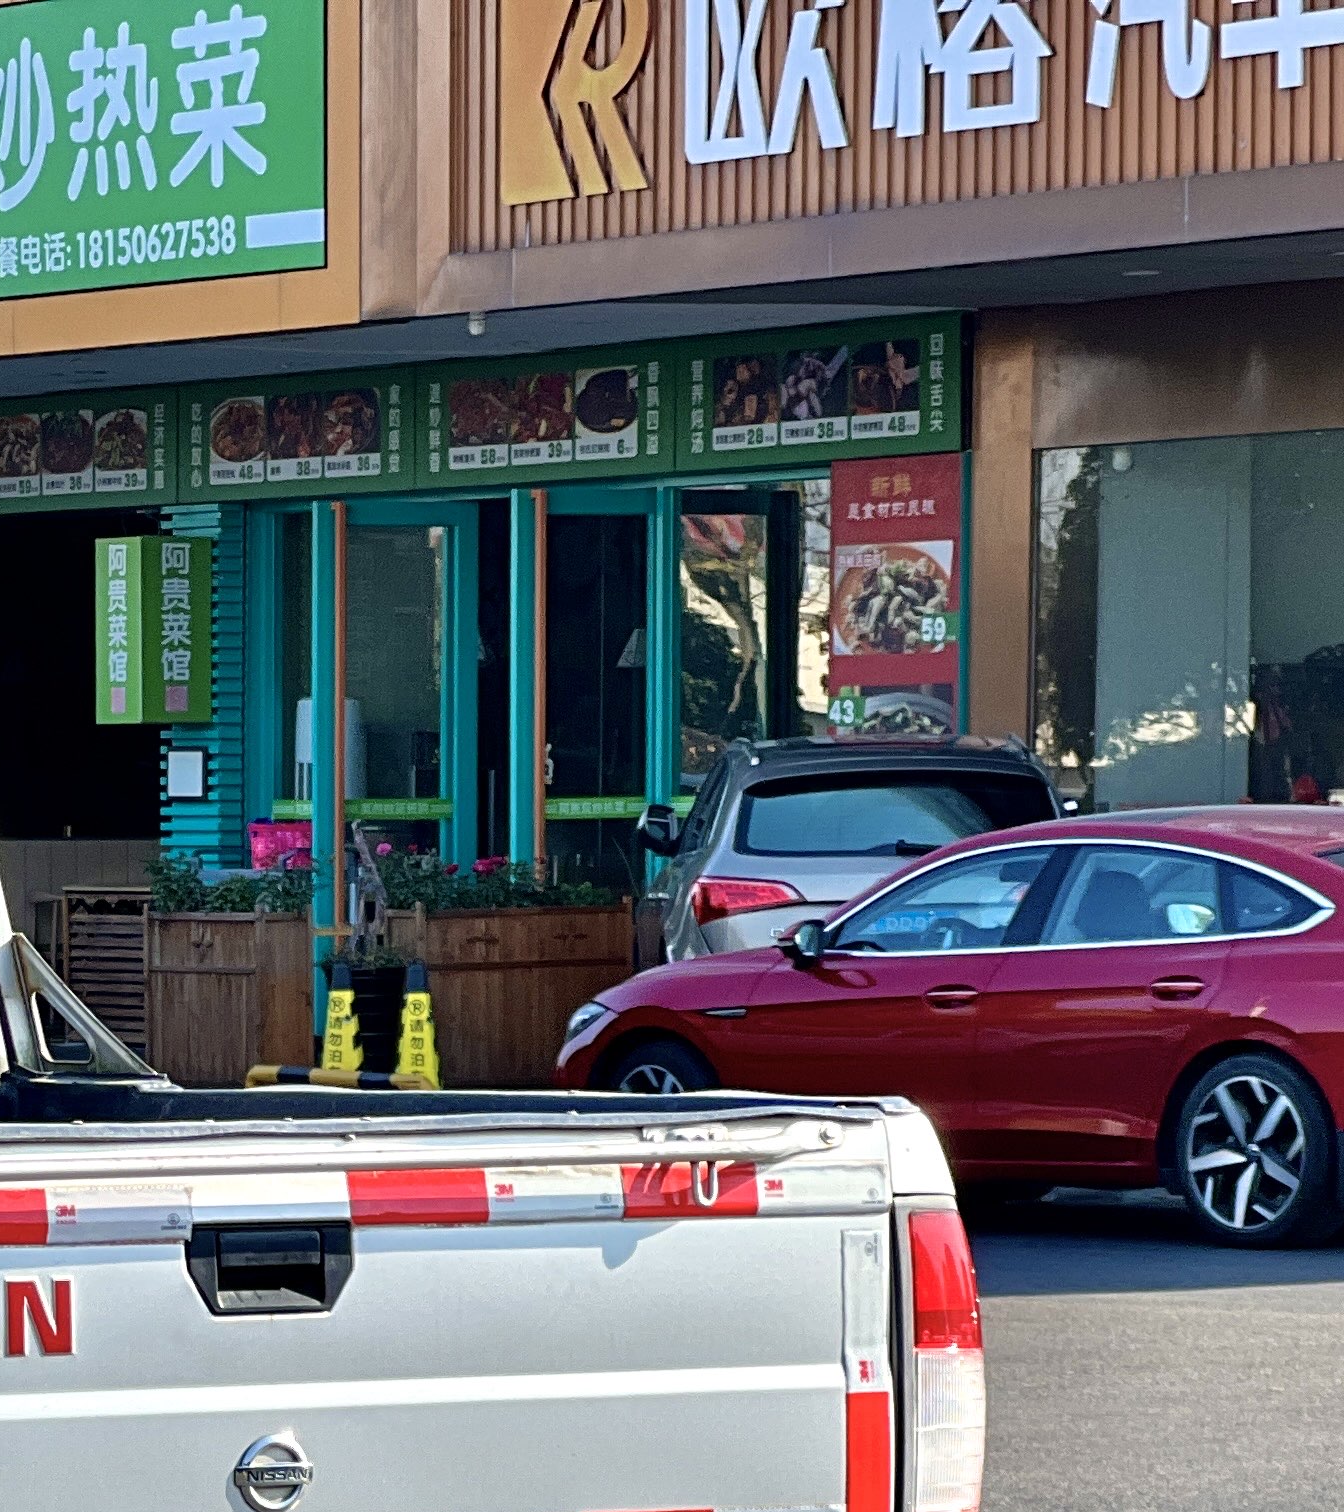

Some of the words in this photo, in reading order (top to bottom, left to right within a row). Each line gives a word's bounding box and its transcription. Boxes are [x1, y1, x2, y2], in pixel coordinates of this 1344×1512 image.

[107, 543, 128, 683] 阿贵菜馆
[160, 542, 192, 682] 阿贵菜馆
[921, 616, 947, 643] 59
[828, 699, 855, 724] 43
[328, 1016, 343, 1070] 请勿泊
[410, 1019, 425, 1074] 请勿泊
[247, 1469, 310, 1482] NISSAN
